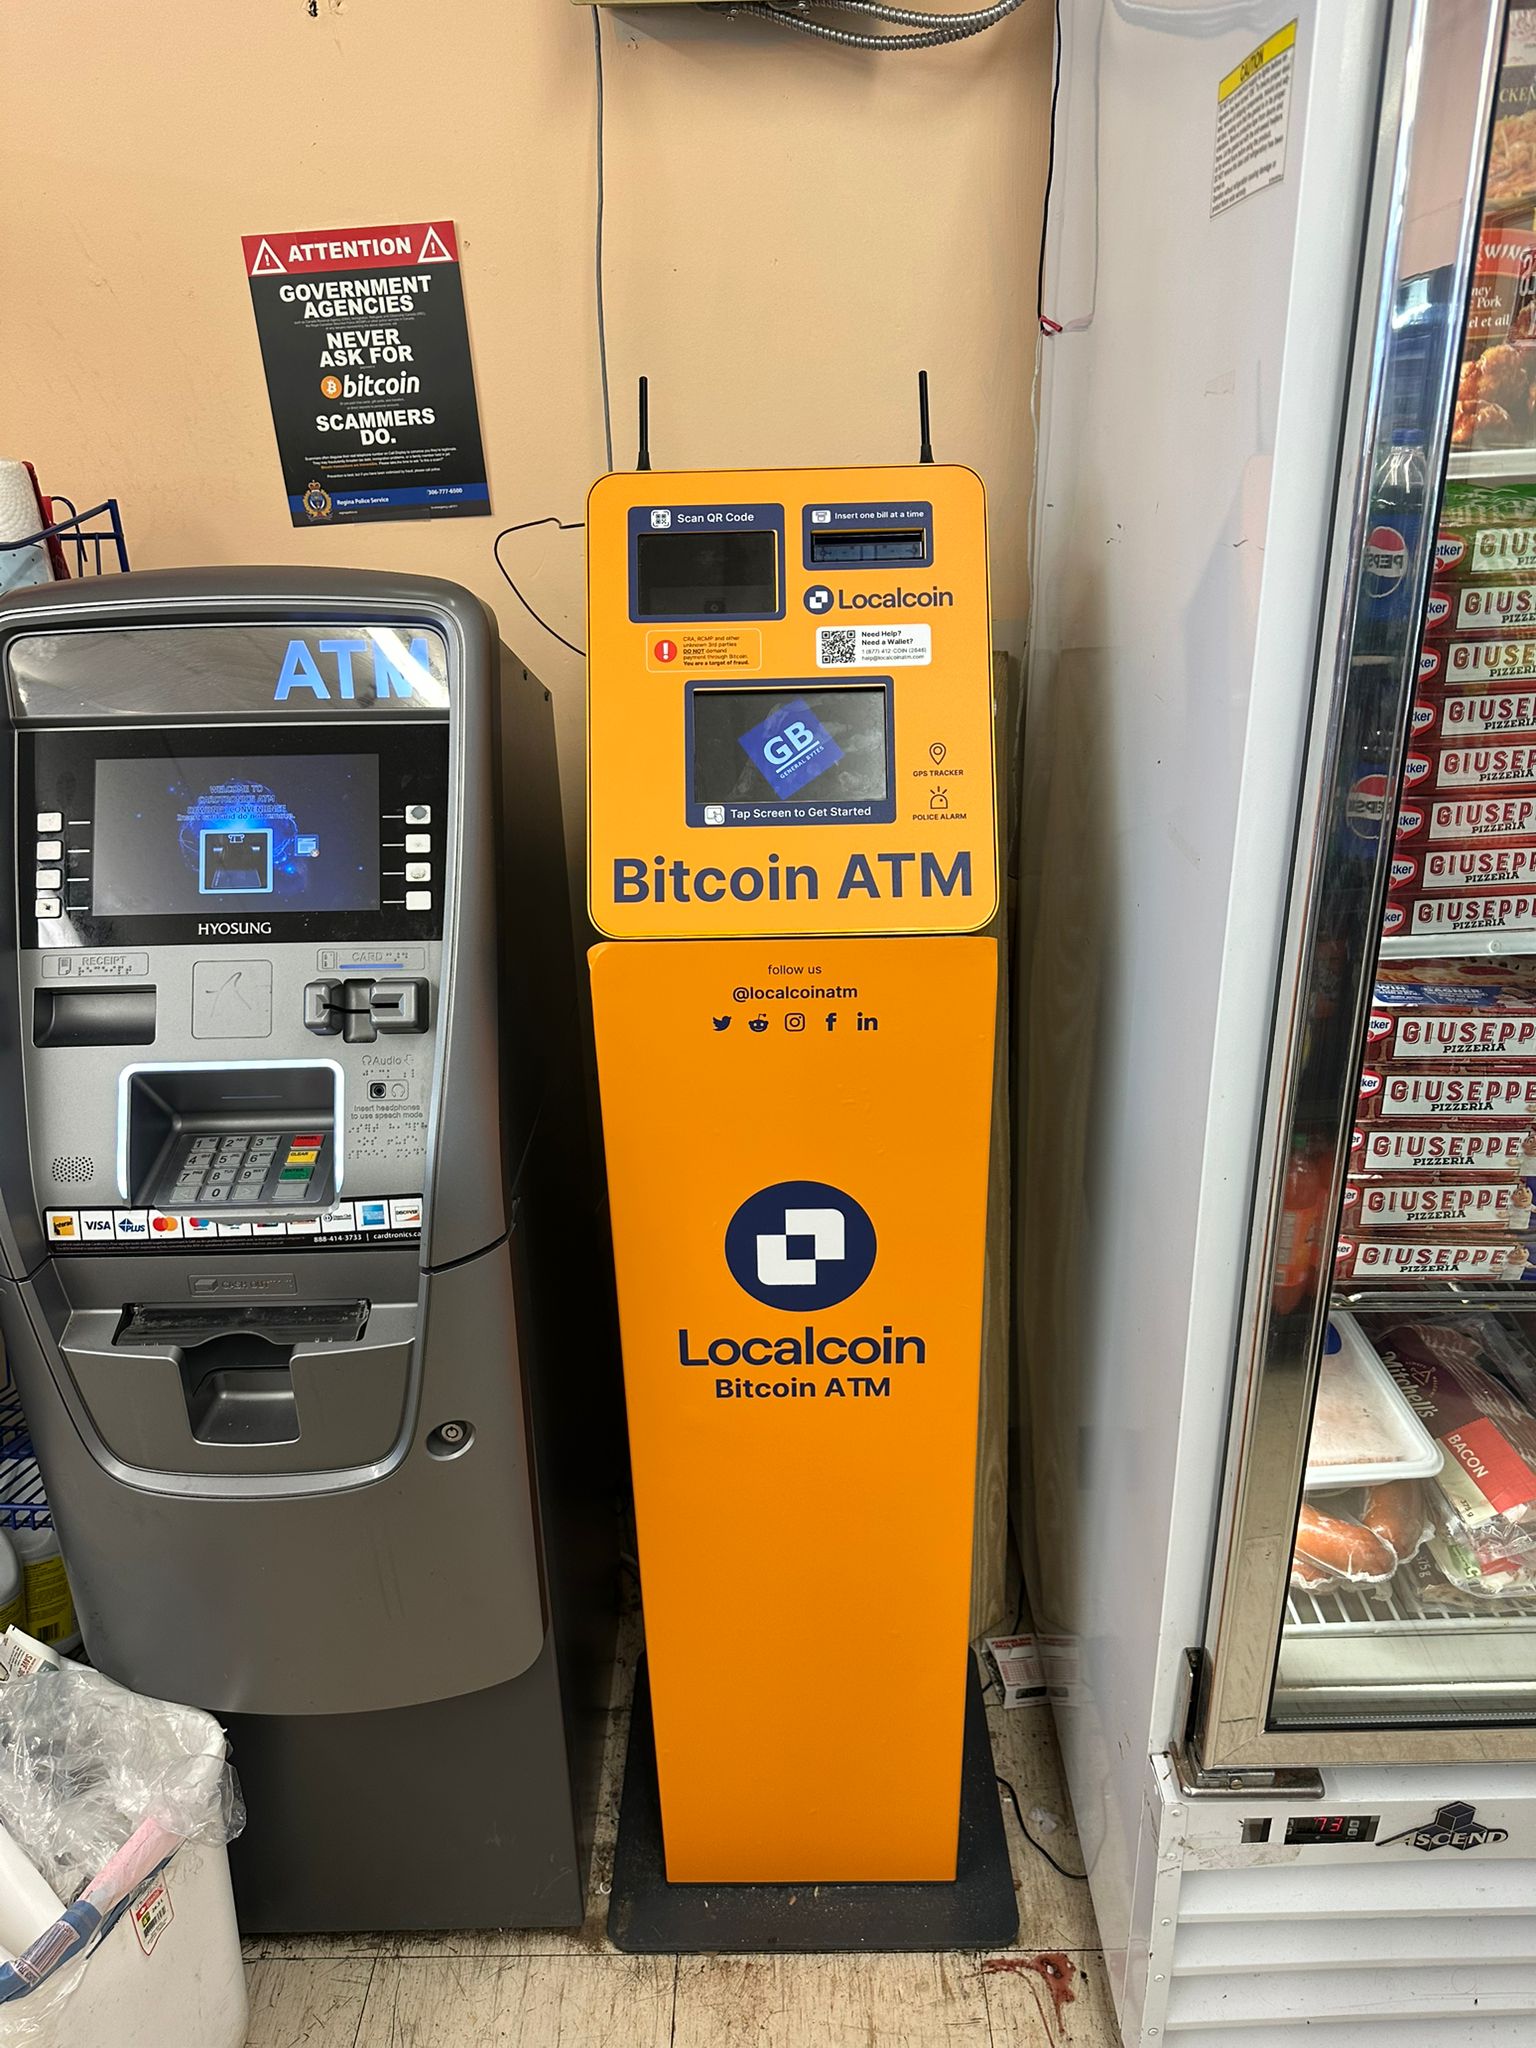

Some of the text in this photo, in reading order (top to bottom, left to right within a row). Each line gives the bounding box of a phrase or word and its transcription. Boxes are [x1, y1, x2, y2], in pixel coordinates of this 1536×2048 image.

[1240, 47, 1264, 82] CAUTION
[288, 236, 412, 262] ATTENTION
[279, 275, 431, 303] GOVERNMENT
[303, 295, 414, 319] AGENCIES
[1477, 296, 1502, 308] Pork
[1481, 318, 1492, 328] et
[1494, 314, 1510, 326] ail
[326, 328, 401, 350] NEVER
[319, 345, 414, 368] ASK FOR
[343, 370, 420, 398] bitcoin
[315, 408, 436, 432] SCAMMERS
[360, 428, 397, 446] DO.
[337, 496, 389, 507] Regina Police Service
[677, 512, 754, 524] Scan QR Code
[834, 512, 857, 520] Insert
[876, 511, 888, 519] bill
[889, 511, 898, 519] at
[906, 510, 924, 518] time
[838, 586, 954, 610] Localcoin
[274, 638, 431, 700] ATM
[763, 721, 814, 766] GB
[780, 745, 825, 780] GENERAL BYTES
[930, 769, 964, 777] TRACKER
[1479, 769, 1534, 781] PIZZERIA
[730, 805, 872, 822] Tap Screen to Get Started
[940, 813, 967, 821] ALARM
[1472, 821, 1526, 834] PIZZERIA
[613, 851, 973, 903] Bitcoin ATM
[1465, 871, 1519, 883] PIZZERIA
[198, 922, 272, 936] HYOSUNG
[1453, 918, 1505, 930] PIZZERIA
[82, 956, 126, 966] RECEIPT
[352, 952, 383, 962] CARD
[767, 964, 822, 975] follow us
[732, 985, 858, 1003] @localcoinatm
[1443, 1042, 1506, 1053] PIZZERIA
[373, 1056, 402, 1065] Audio
[1390, 1080, 1536, 1103] GIUSEPPE
[376, 1104, 420, 1113] headphones
[1431, 1101, 1494, 1112] PIZZERIA
[375, 1111, 401, 1121] speech
[403, 1111, 424, 1119] mode
[196, 1136, 263, 1148] 1 2 3
[1373, 1136, 1520, 1157] GIUSEPPE
[188, 1153, 258, 1165] 4 5 6
[1413, 1156, 1475, 1165] PIZZERIA
[182, 1171, 252, 1182] 7 8 9
[211, 1188, 221, 1197] 0
[1368, 1189, 1511, 1213] GIUSEPPE
[396, 1208, 418, 1216] DISCOVER
[1407, 1210, 1466, 1221] PIZZERIA
[84, 1220, 112, 1230] VISA
[126, 1224, 146, 1233] PLUS
[1362, 1247, 1507, 1265] GIUSEPPE
[1400, 1264, 1459, 1273] PIZZERIA
[678, 1325, 926, 1367] Localcoin
[715, 1377, 890, 1399] Bitcoin ATM
[1382, 1352, 1439, 1420] Mitchell's
[1447, 1434, 1489, 1479] BACON
[1314, 1817, 1344, 1832] 73
[1403, 1831, 1509, 1847] ASCEND
